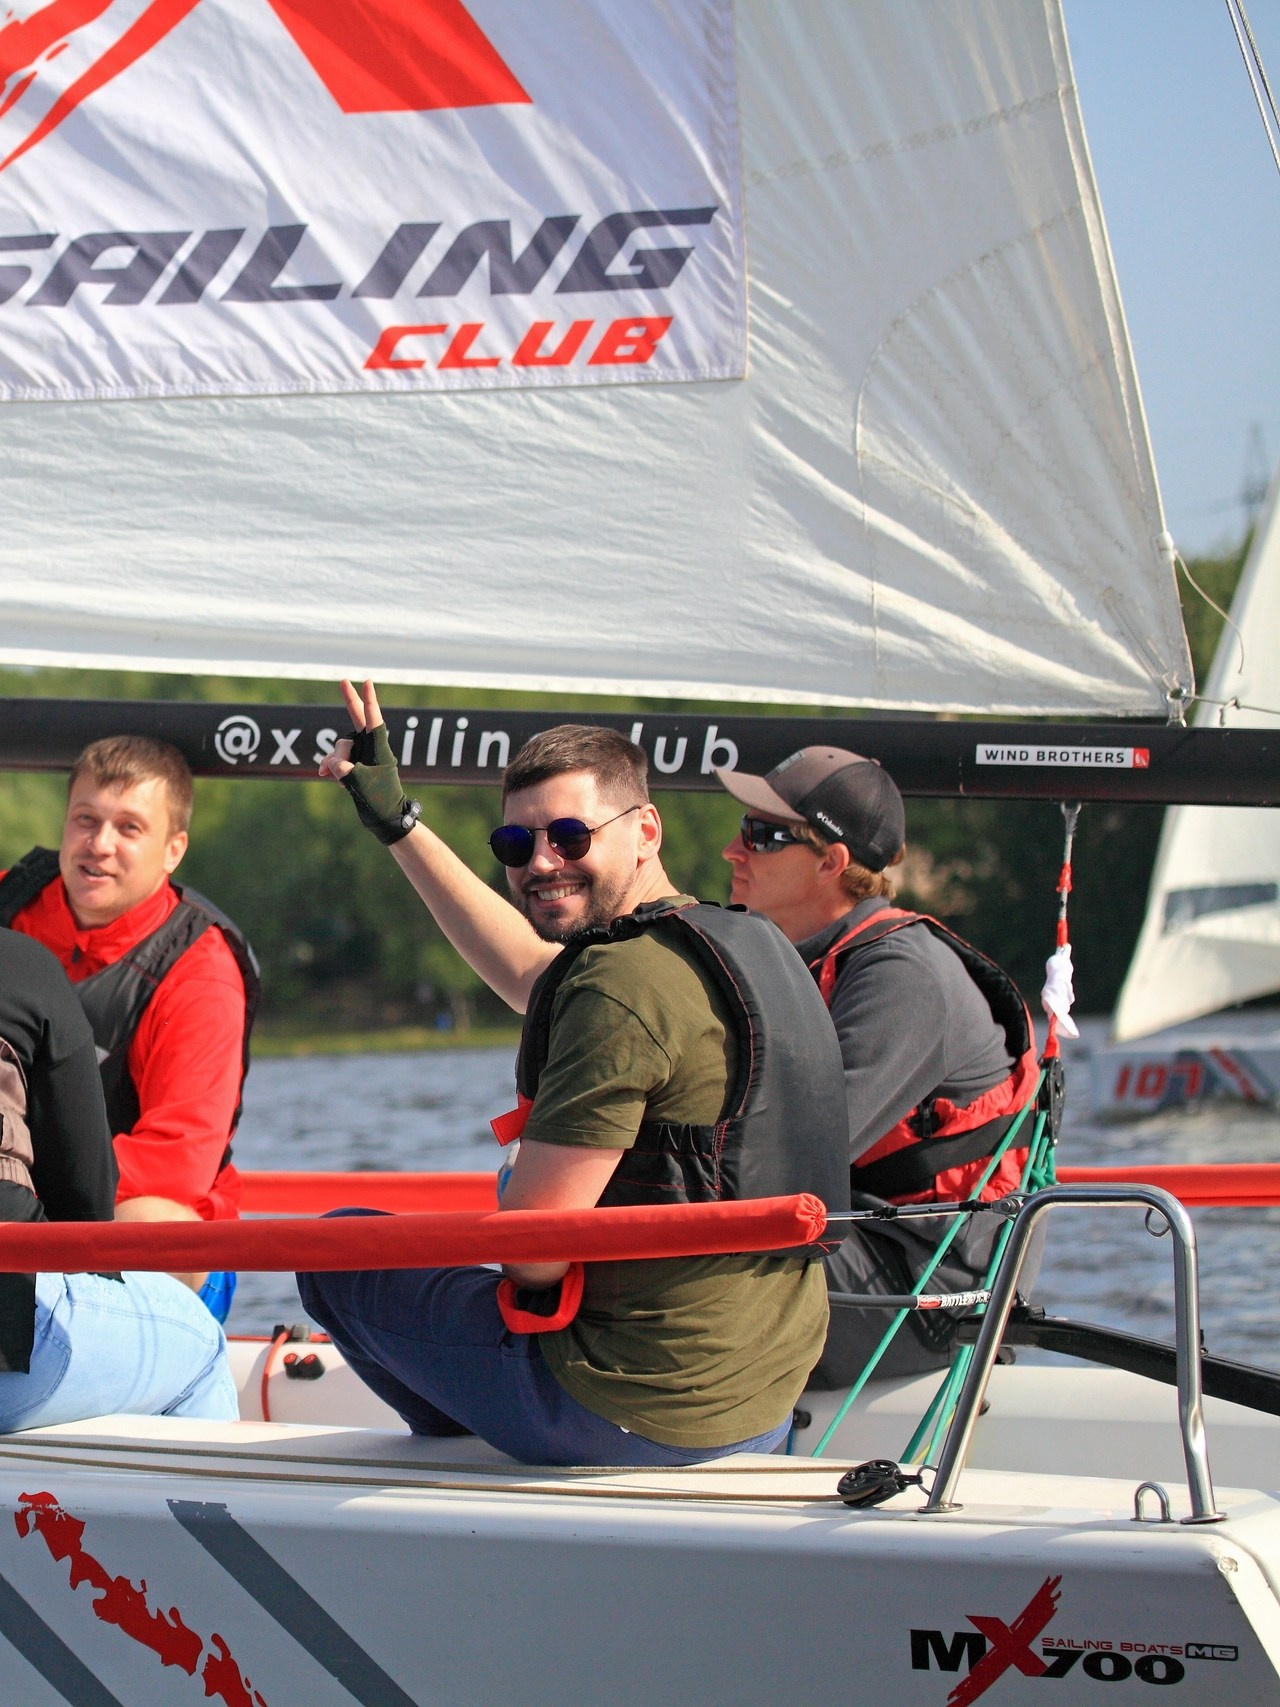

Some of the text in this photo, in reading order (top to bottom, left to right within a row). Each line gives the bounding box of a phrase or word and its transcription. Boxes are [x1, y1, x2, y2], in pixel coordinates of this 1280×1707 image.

[363, 316, 673, 370] CLUB
[215, 715, 739, 775] @xsilinub
[985, 750, 1125, 764] WIND BROTHERS
[1115, 1062, 1202, 1099] 107
[1041, 1637, 1236, 1660] SAILING BOATS MG
